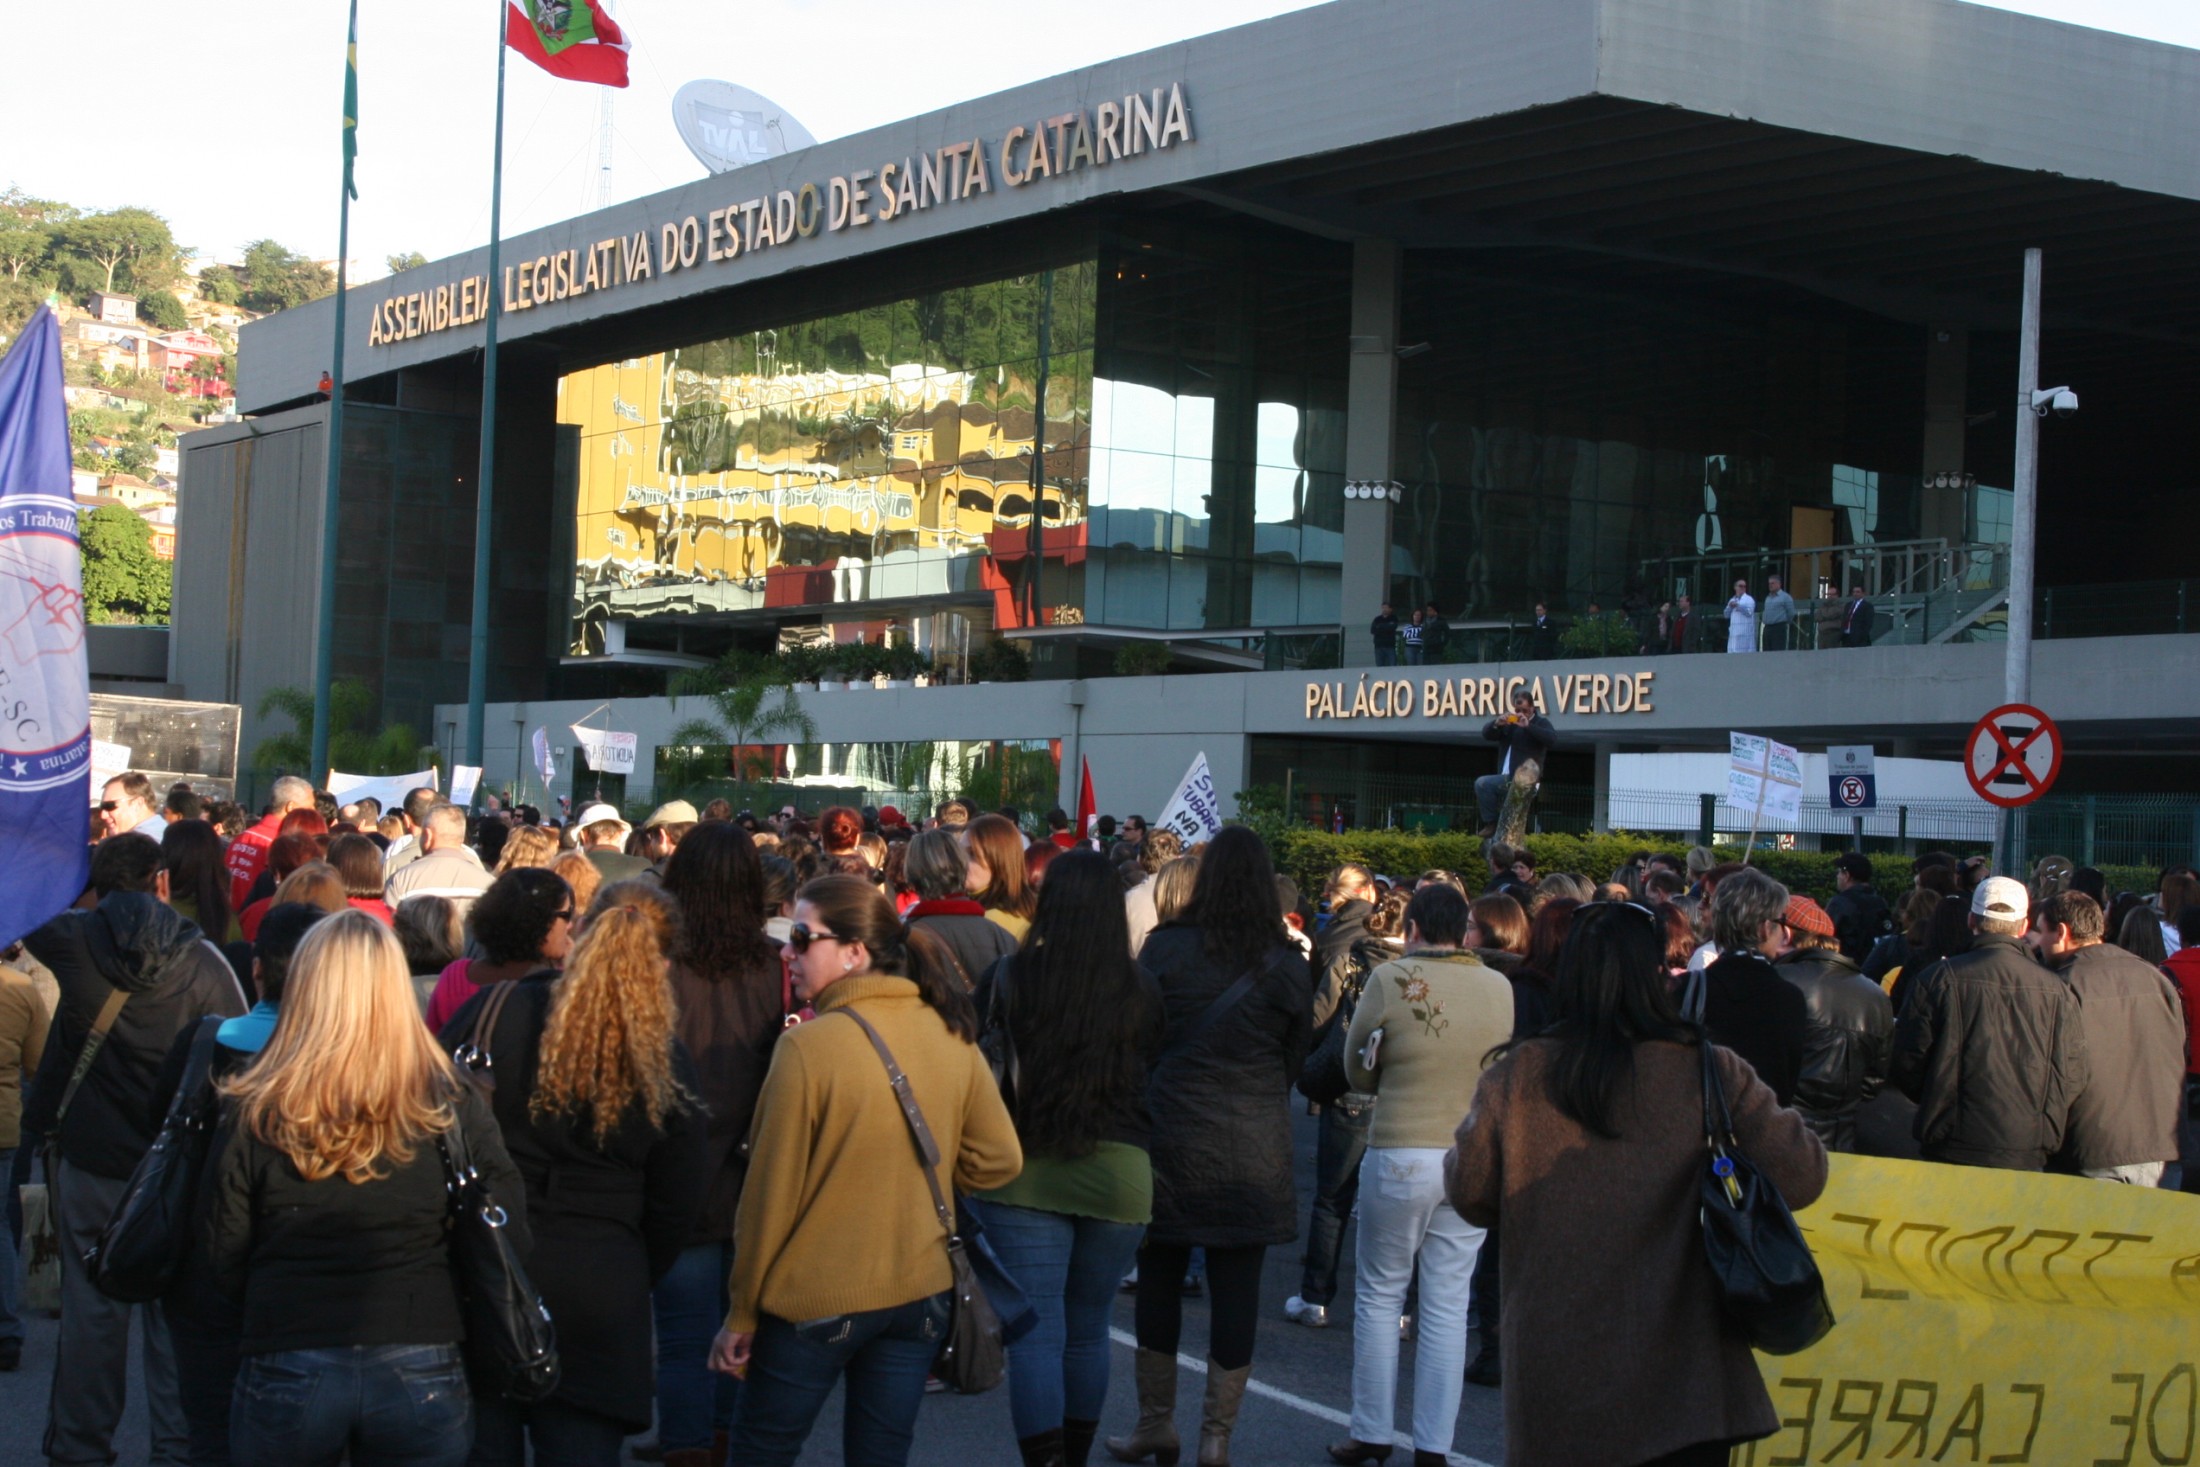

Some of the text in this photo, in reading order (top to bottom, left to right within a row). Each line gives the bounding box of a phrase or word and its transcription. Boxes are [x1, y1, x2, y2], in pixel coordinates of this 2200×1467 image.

[504, 230, 653, 312] LEGISLATIVA
[661, 216, 702, 274] DO
[707, 183, 821, 262] ESTADO
[828, 169, 873, 232] DE
[879, 137, 991, 222] SANTA
[1001, 82, 1193, 187] CATARINA
[1305, 673, 1414, 720] PALÁCIO
[1553, 671, 1655, 713] VERDE
[1174, 810, 1200, 837] NA
